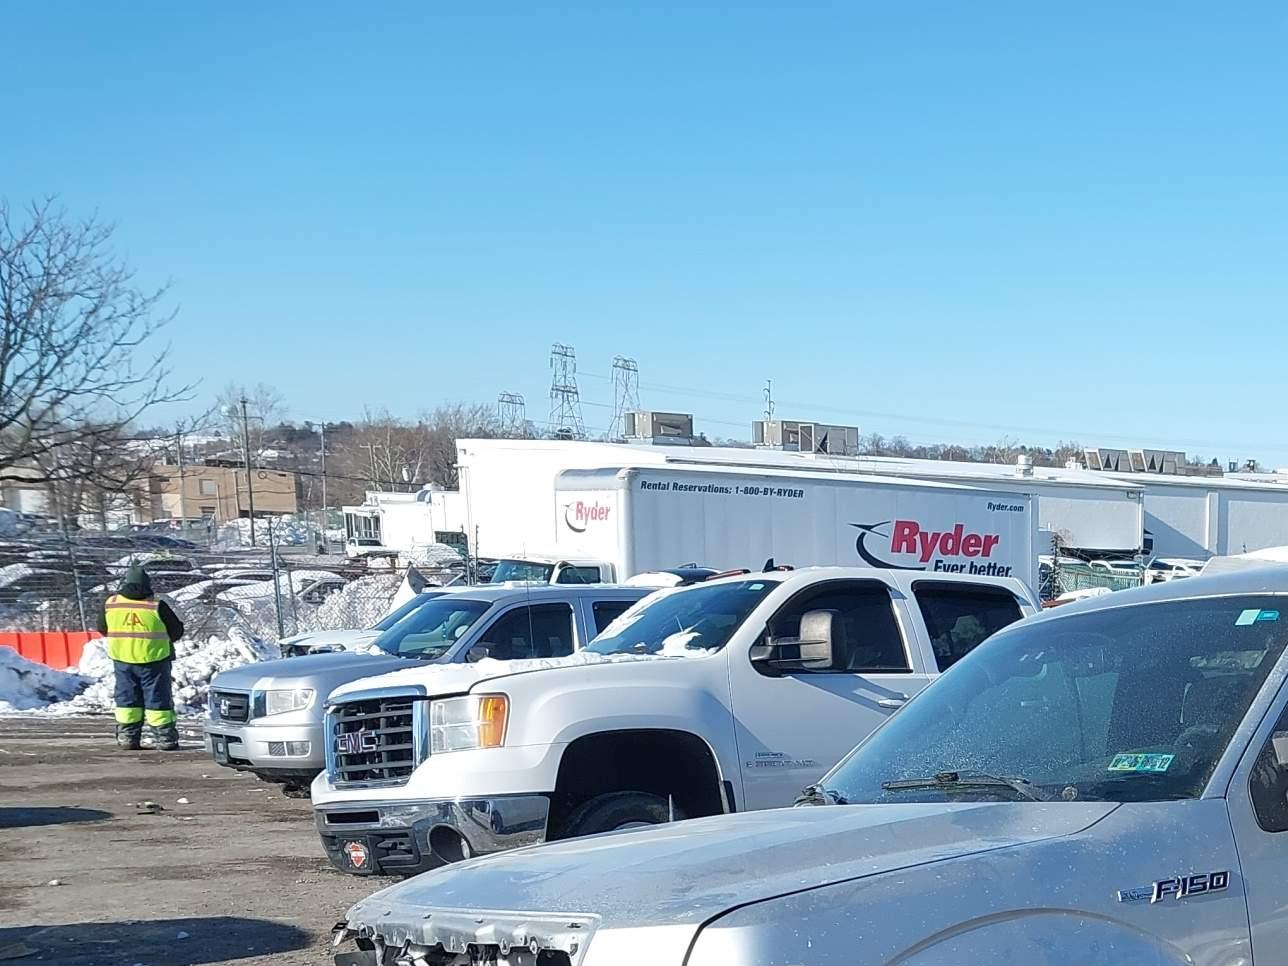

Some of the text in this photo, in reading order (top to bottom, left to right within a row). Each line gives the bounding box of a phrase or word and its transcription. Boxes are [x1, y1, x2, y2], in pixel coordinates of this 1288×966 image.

[640, 481, 805, 498] Rental Reservations: 1-800-BY-RYDER
[576, 500, 611, 526] Ryder
[987, 502, 1025, 512] Ryder.com
[891, 520, 999, 563] Ryder
[934, 560, 966, 574] Ever
[337, 731, 377, 754] GMC
[1151, 871, 1231, 904] F-150
